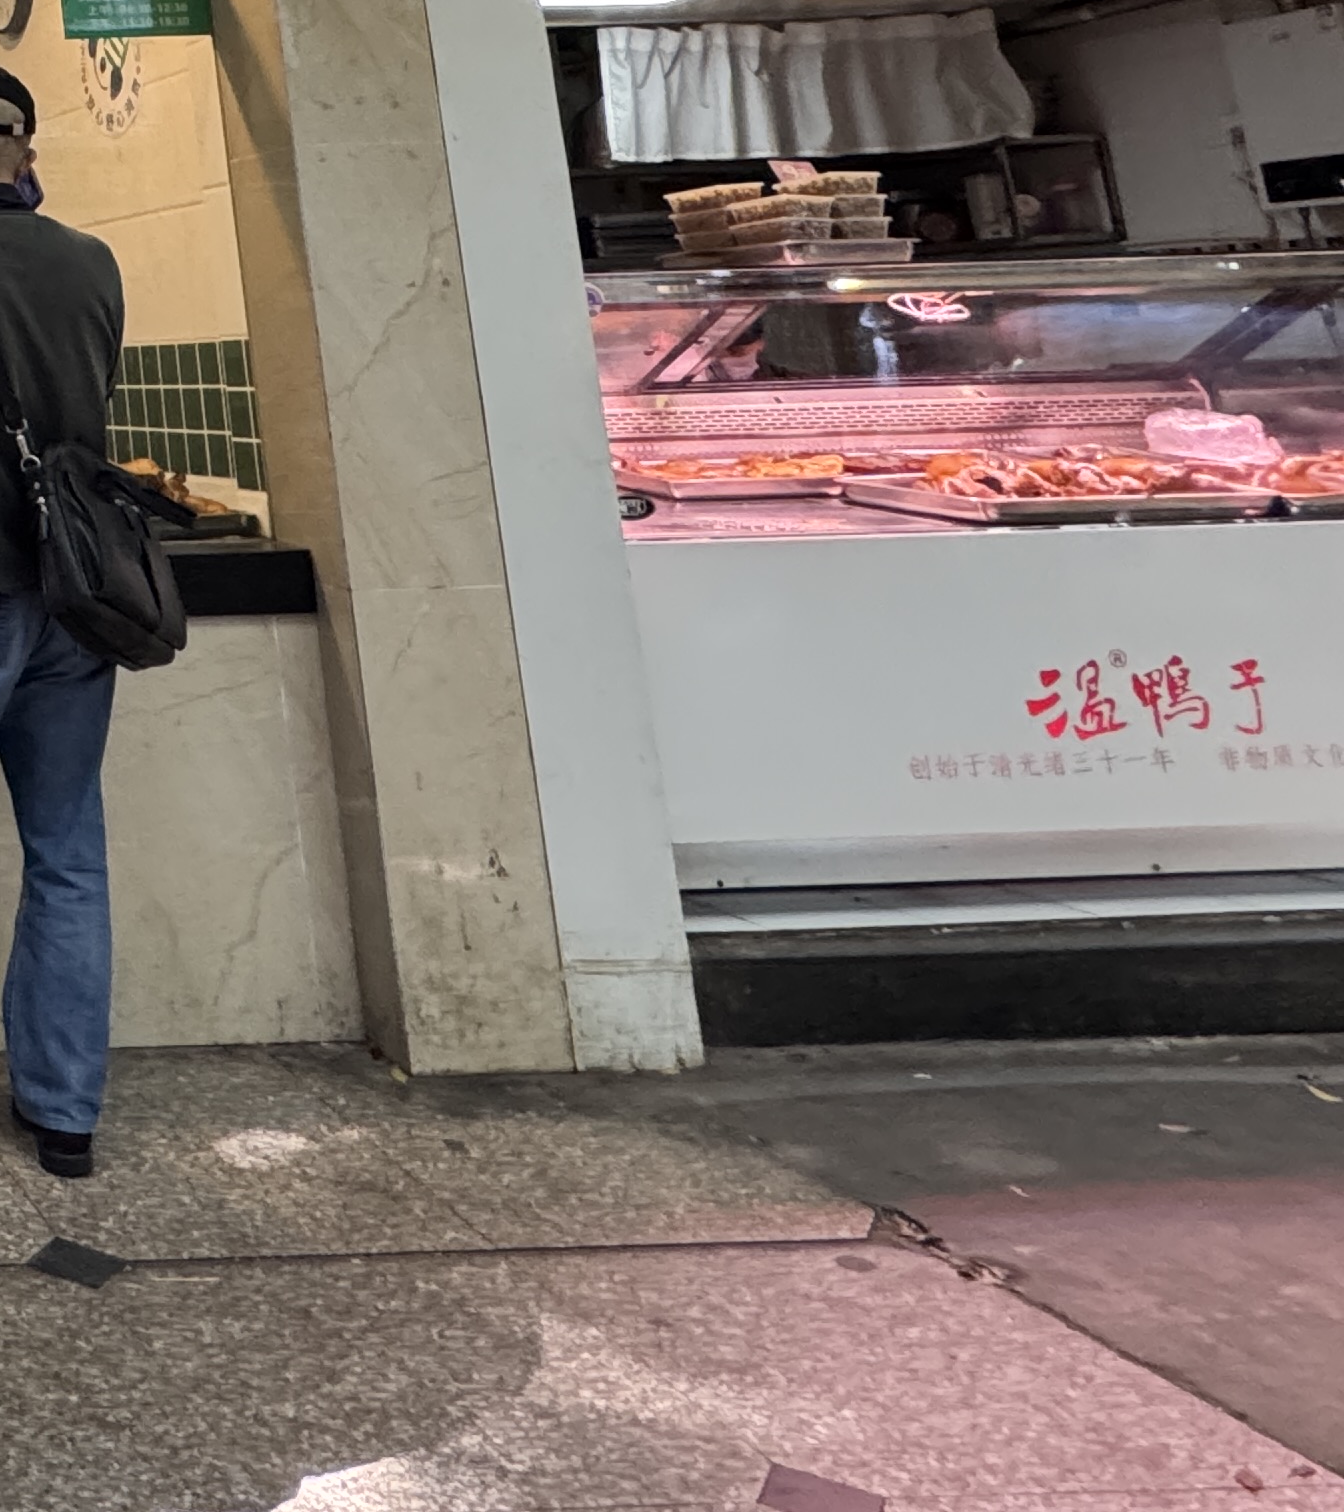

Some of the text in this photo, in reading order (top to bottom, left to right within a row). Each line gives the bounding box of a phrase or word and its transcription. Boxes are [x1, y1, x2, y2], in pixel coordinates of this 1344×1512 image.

[909, 746, 1175, 781] 创始于清光绪三十一年
